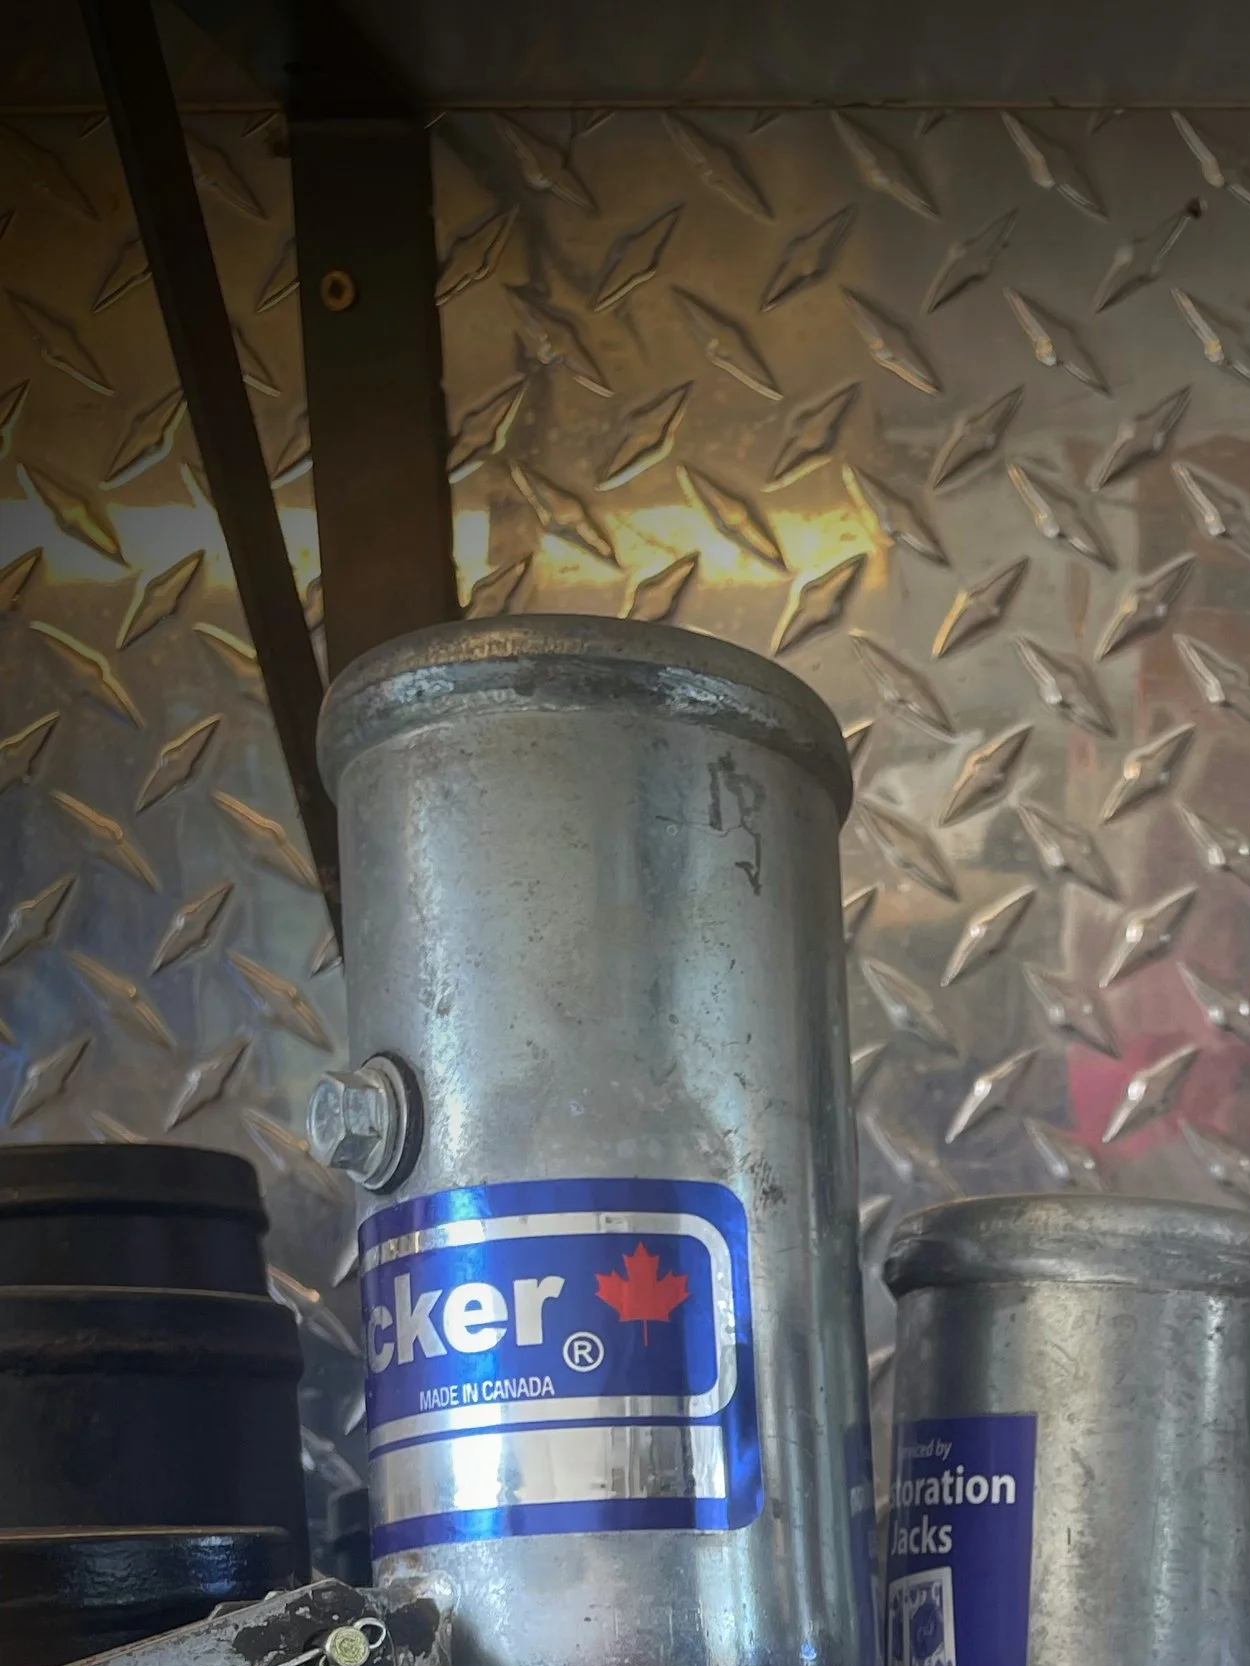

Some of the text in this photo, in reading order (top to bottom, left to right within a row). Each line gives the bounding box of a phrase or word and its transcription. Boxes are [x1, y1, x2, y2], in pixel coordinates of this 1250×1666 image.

[419, 1376, 555, 1410] MADE IN CANADA
[891, 1514, 953, 1555] Jacks
